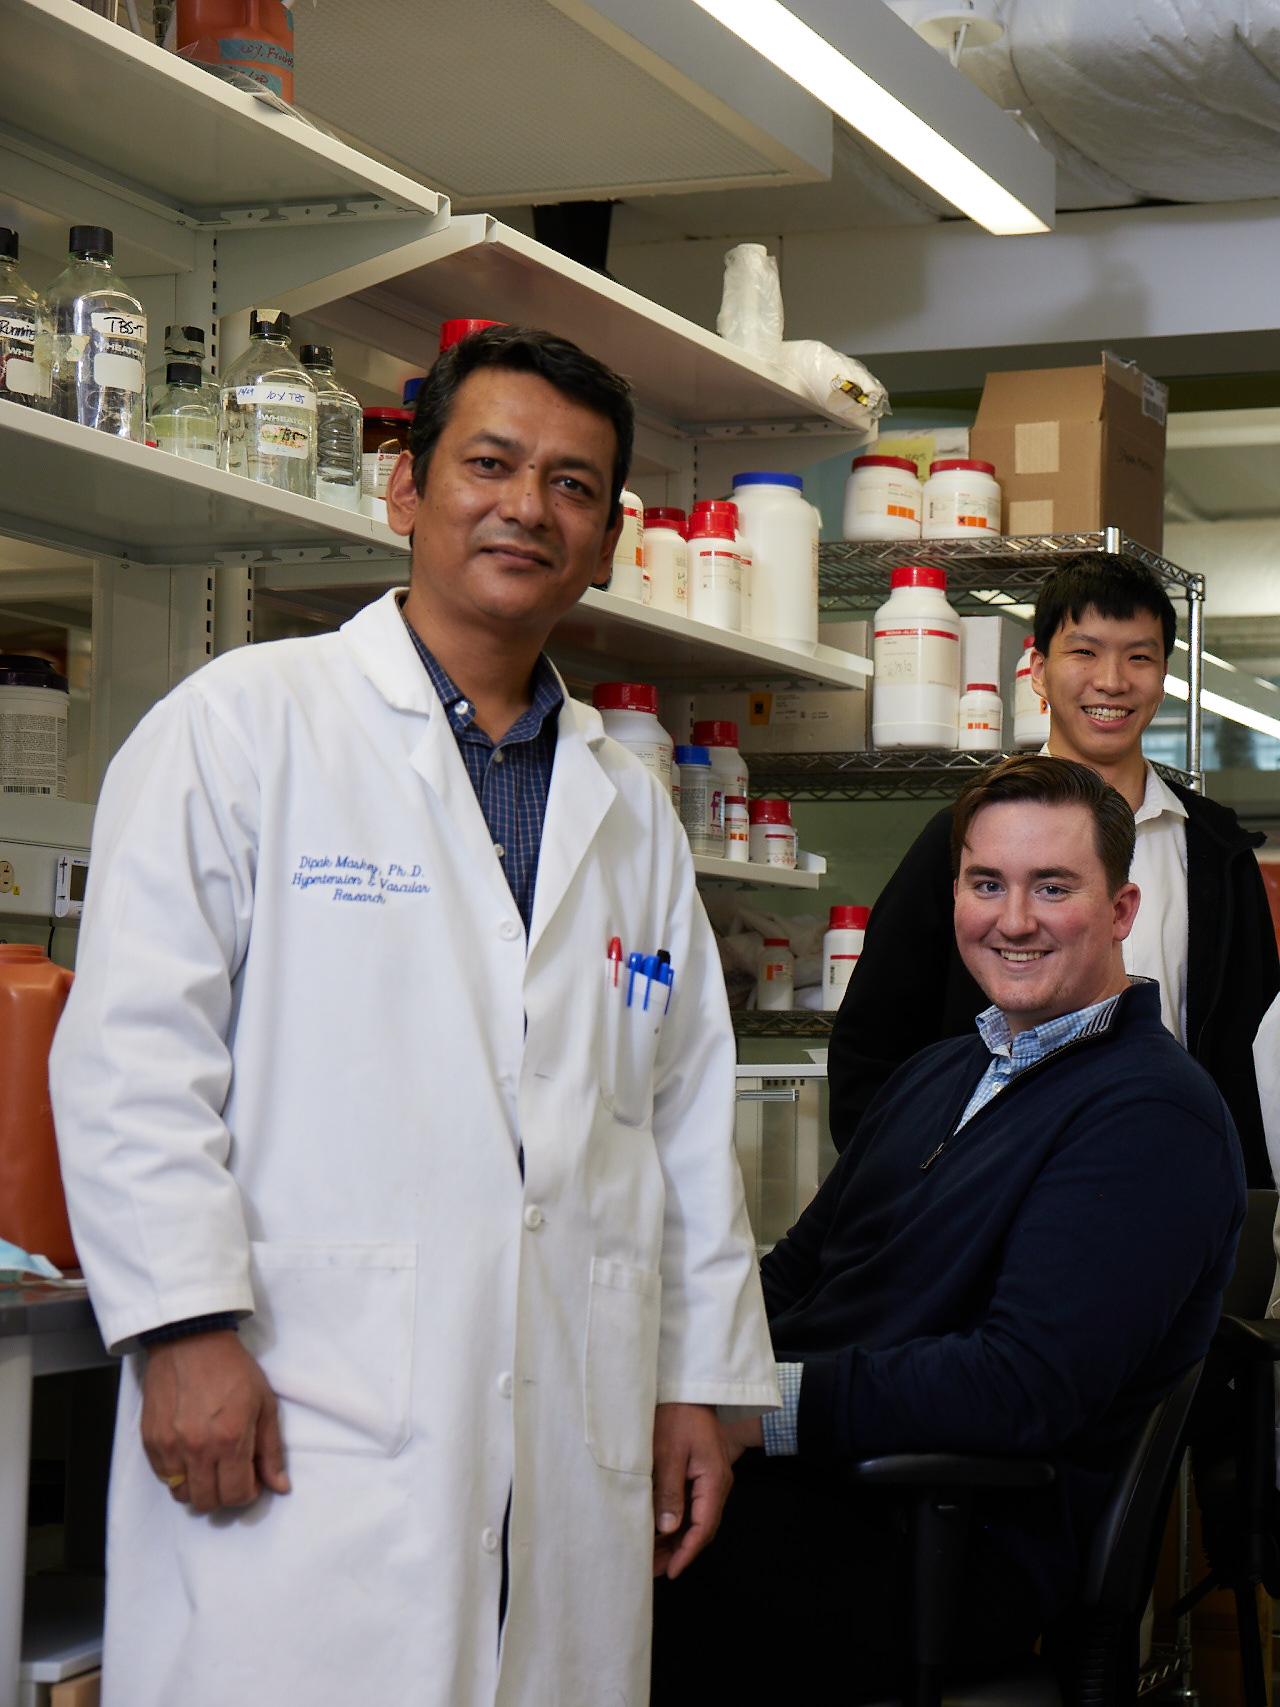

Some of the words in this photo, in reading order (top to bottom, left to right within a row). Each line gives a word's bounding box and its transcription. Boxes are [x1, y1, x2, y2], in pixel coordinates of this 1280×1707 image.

[299, 855, 332, 871] Dipak
[380, 878, 430, 894] Vascular
[333, 888, 387, 905] Research
